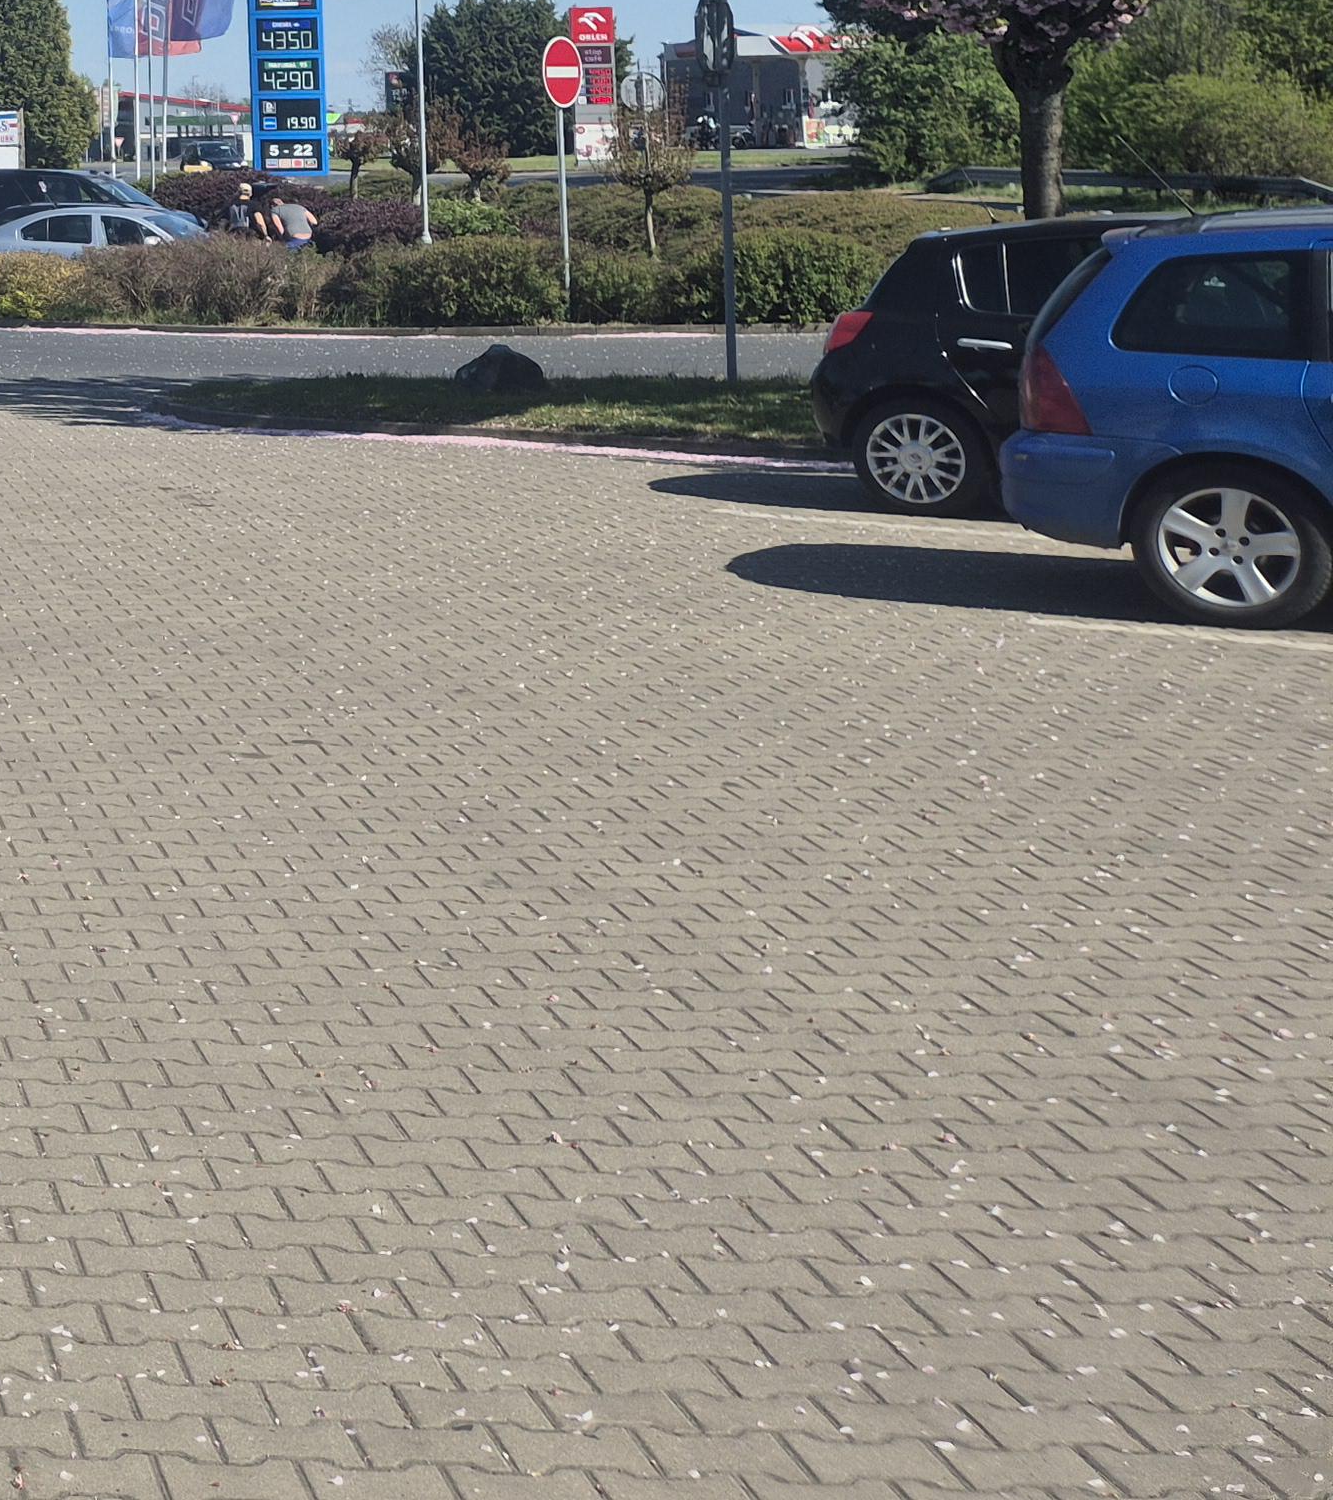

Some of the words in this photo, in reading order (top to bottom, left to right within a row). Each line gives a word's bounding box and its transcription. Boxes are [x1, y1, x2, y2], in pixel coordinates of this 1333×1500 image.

[261, 30, 312, 49] 4350
[578, 33, 608, 41] ORLEN
[263, 71, 313, 89] 4290
[287, 117, 316, 129] 19.90
[269, 144, 280, 156] 5
[293, 143, 313, 156] 22
